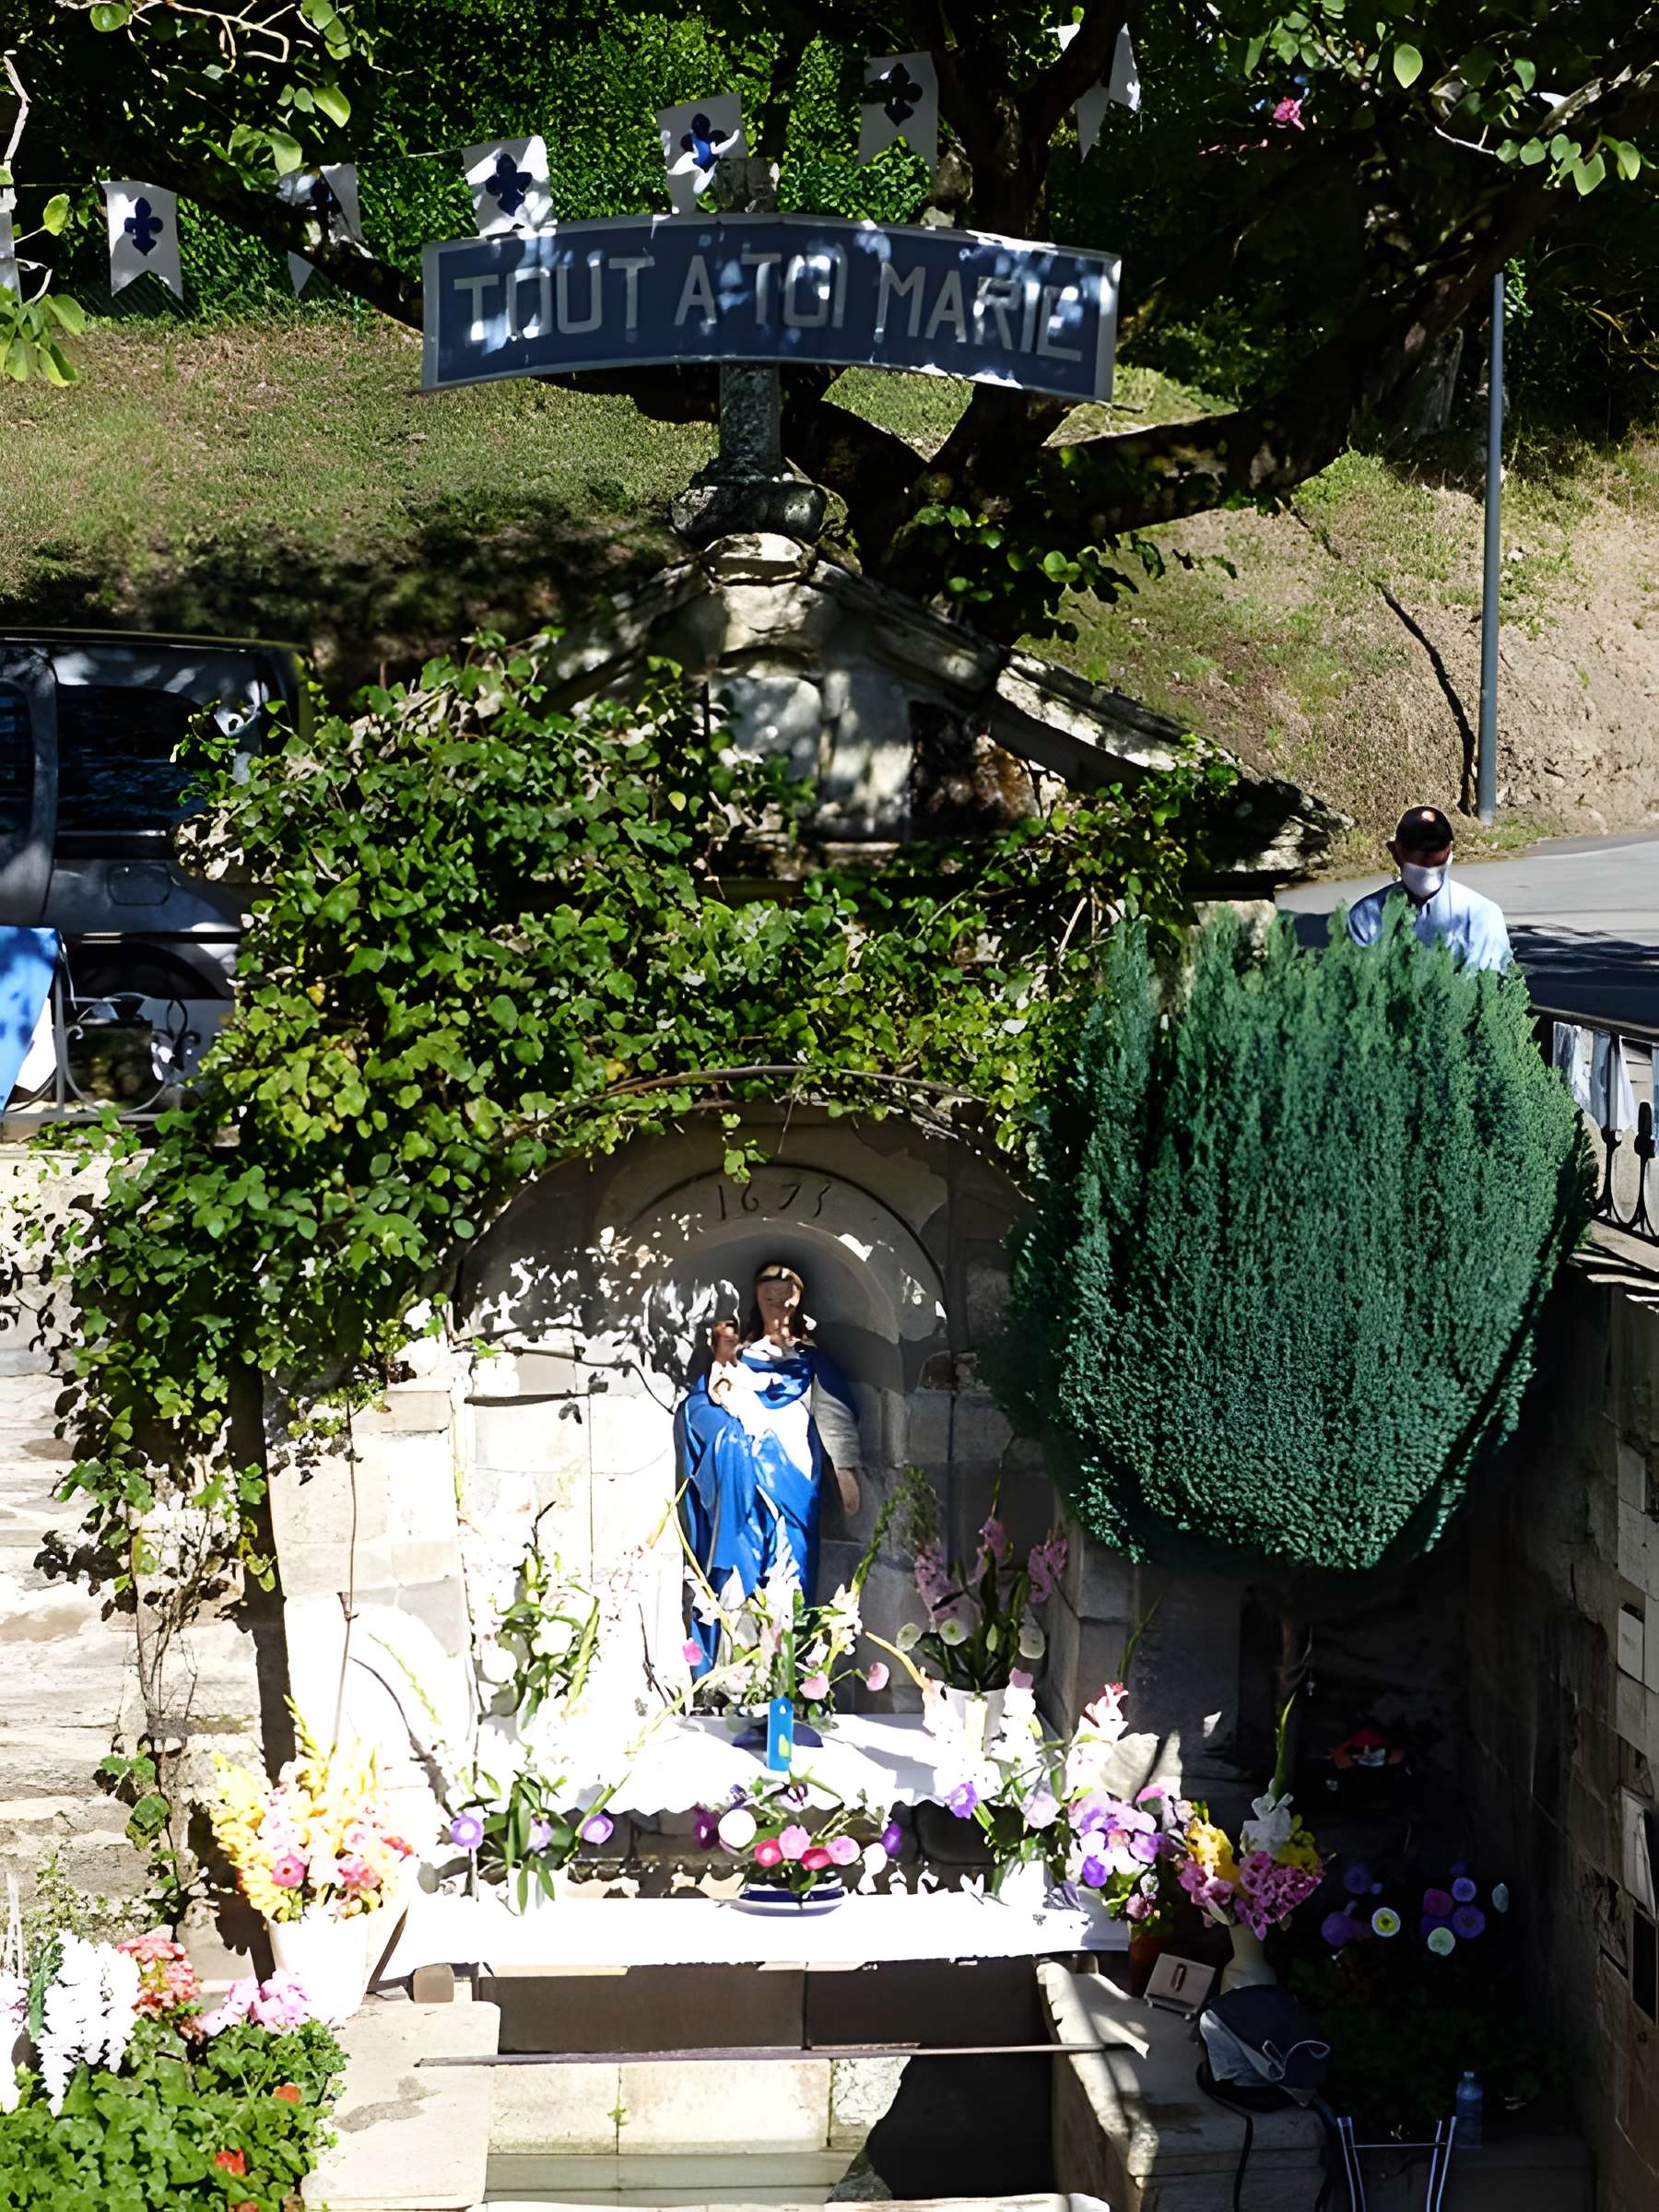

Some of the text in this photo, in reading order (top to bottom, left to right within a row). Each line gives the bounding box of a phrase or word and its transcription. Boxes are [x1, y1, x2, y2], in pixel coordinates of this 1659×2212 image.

[454, 249, 1083, 361] TOUT A TOI MARIE
